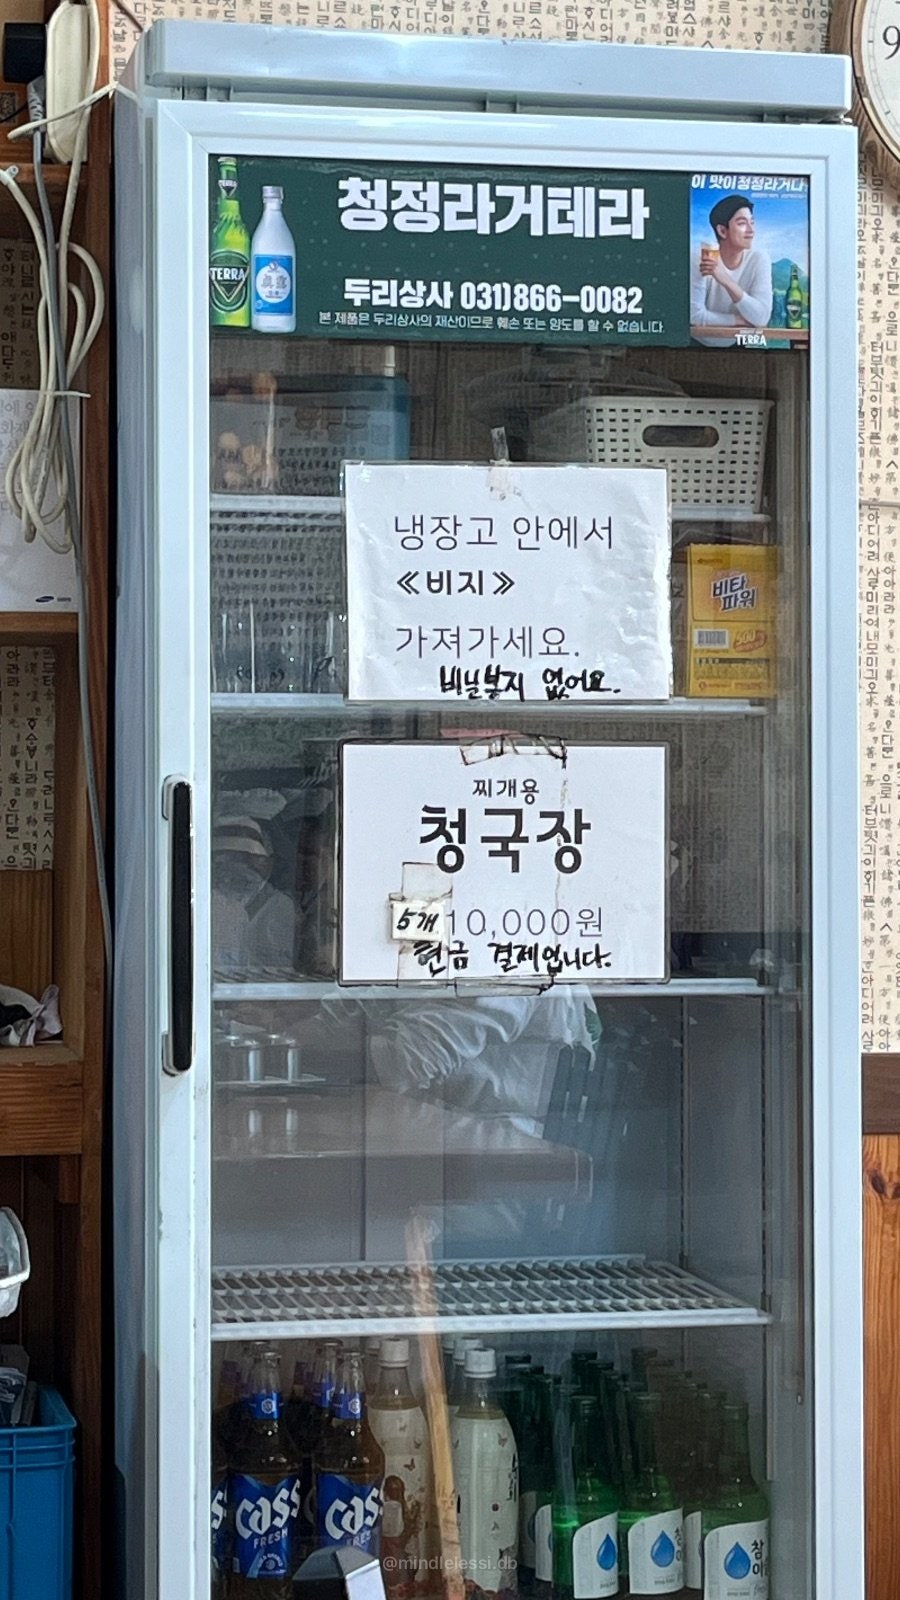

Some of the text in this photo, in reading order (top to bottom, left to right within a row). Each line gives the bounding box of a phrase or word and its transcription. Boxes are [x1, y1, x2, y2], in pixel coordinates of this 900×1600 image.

[338, 177, 650, 240] 청정라거테라
[210, 267, 245, 280] TERRA
[344, 278, 644, 314] 두리상사 031)866-0082
[334, 312, 371, 326] 제품은
[373, 313, 433, 327] 두리상사의
[435, 314, 494, 329] 재산이므로
[523, 317, 547, 331] 또는
[602, 320, 614, 331] 수
[735, 334, 767, 346] TERRA
[394, 514, 613, 551] 냉장고 안에서
[711, 574, 746, 598] 비타
[720, 588, 757, 612] 파워
[395, 625, 581, 659] 가져가세요.
[472, 778, 540, 805] 찌개용
[419, 804, 592, 874] 청국장
[448, 906, 604, 939] 10,000원
[253, 1527, 288, 1549] FRESH
